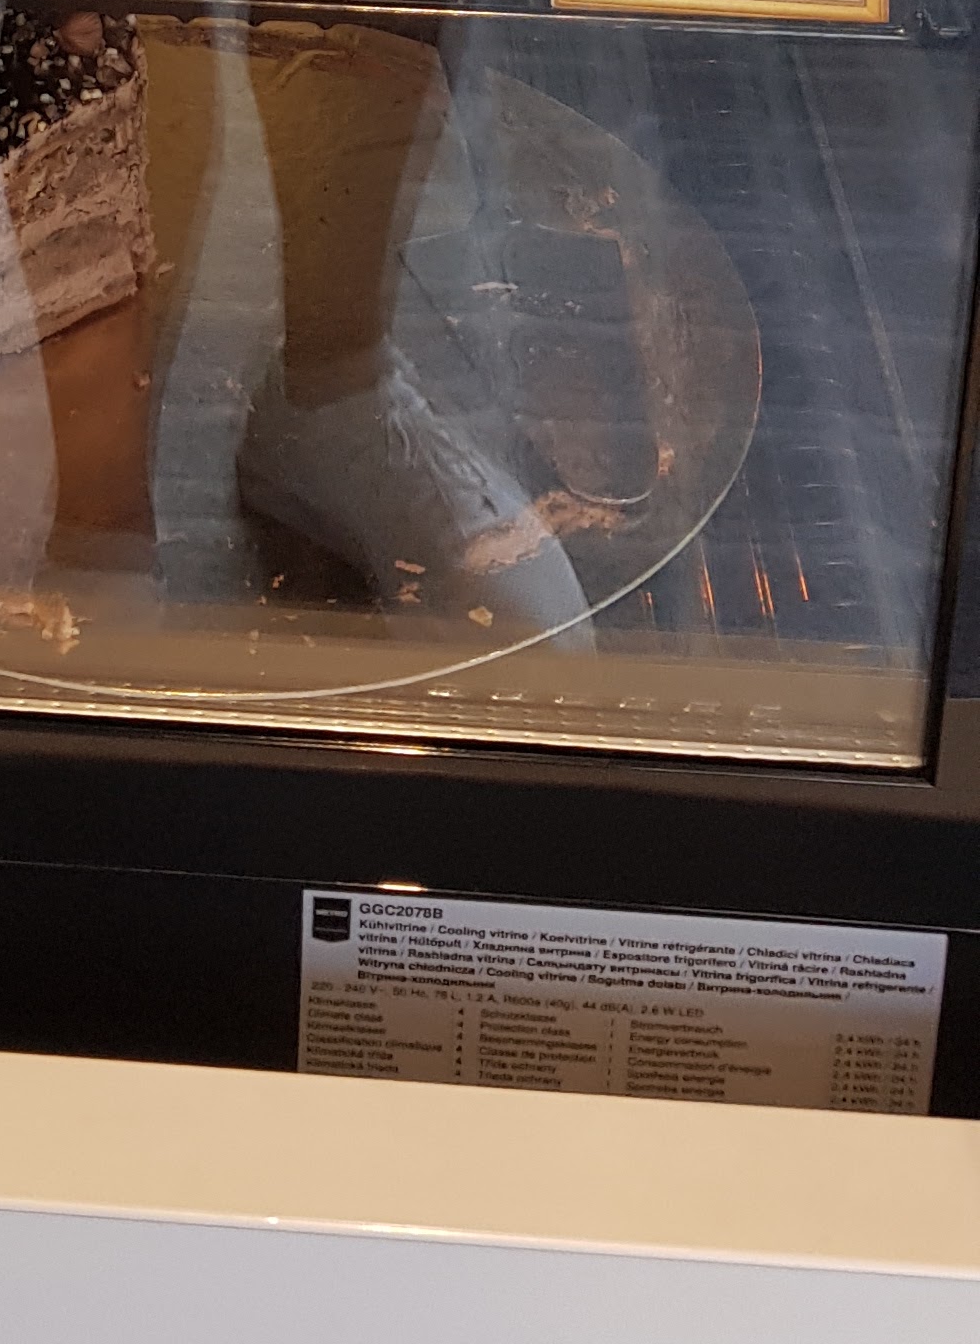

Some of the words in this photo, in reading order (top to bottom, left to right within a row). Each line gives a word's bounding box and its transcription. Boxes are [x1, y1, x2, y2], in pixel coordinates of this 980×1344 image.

[438, 925, 486, 939] Cooling
[490, 928, 529, 941] vitrine
[618, 937, 659, 950] Vitrine
